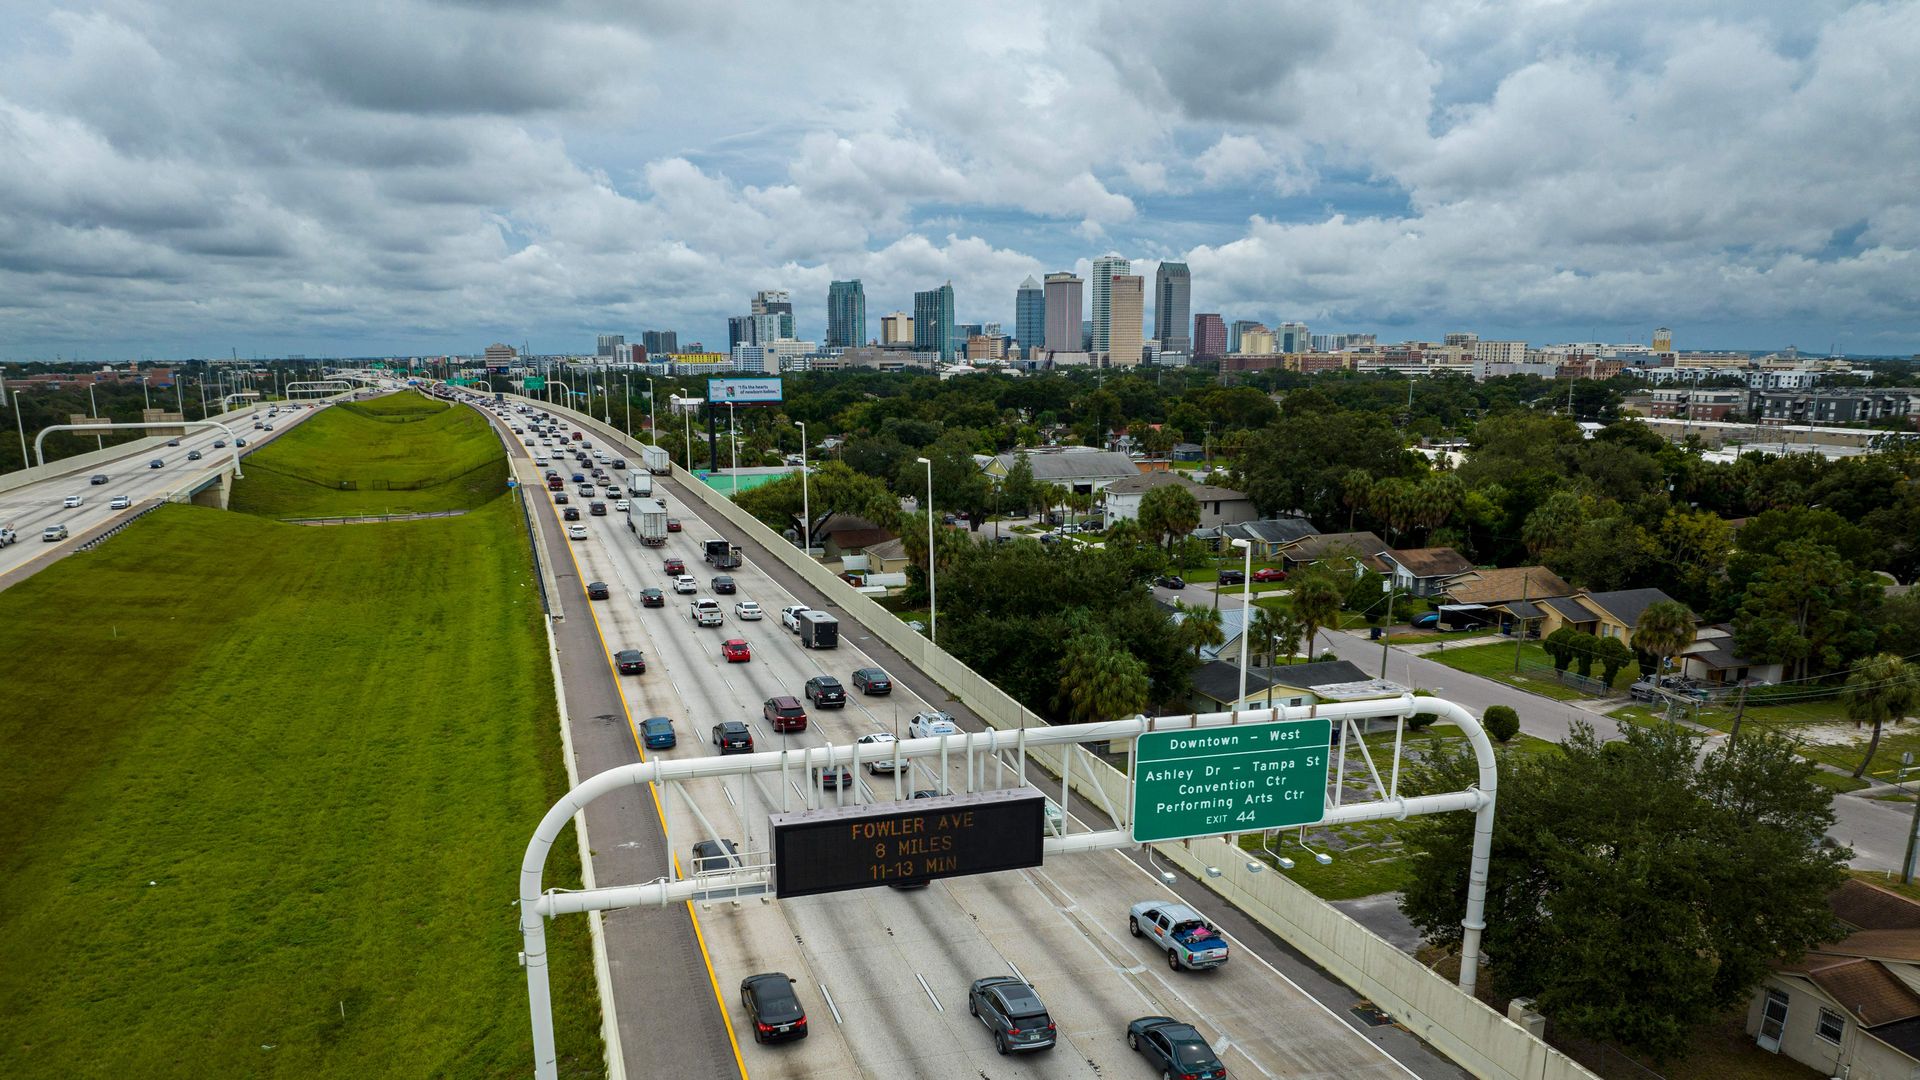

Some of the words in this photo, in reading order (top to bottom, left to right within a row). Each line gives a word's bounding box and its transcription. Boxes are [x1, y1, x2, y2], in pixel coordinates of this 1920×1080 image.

[1170, 735, 1239, 750] Downtown
[1270, 728, 1300, 742] West
[1145, 769, 1194, 782] Ashley
[1205, 766, 1220, 777] Dr
[1253, 759, 1295, 772] Tampa
[1306, 756, 1320, 767] St
[1179, 779, 1255, 795] Convention
[1266, 776, 1287, 786] Ctr
[1157, 798, 1233, 814] Performing
[1245, 794, 1273, 805] Arts
[1284, 790, 1304, 801] Ctr
[852, 817, 924, 840] FOWLER
[938, 811, 975, 830] AVE
[1206, 814, 1228, 825] EXIT
[1236, 810, 1256, 822] 44
[875, 842, 886, 859] 8
[898, 836, 953, 856] MILES
[870, 861, 914, 881] 11-13
[926, 855, 957, 873] MIN
